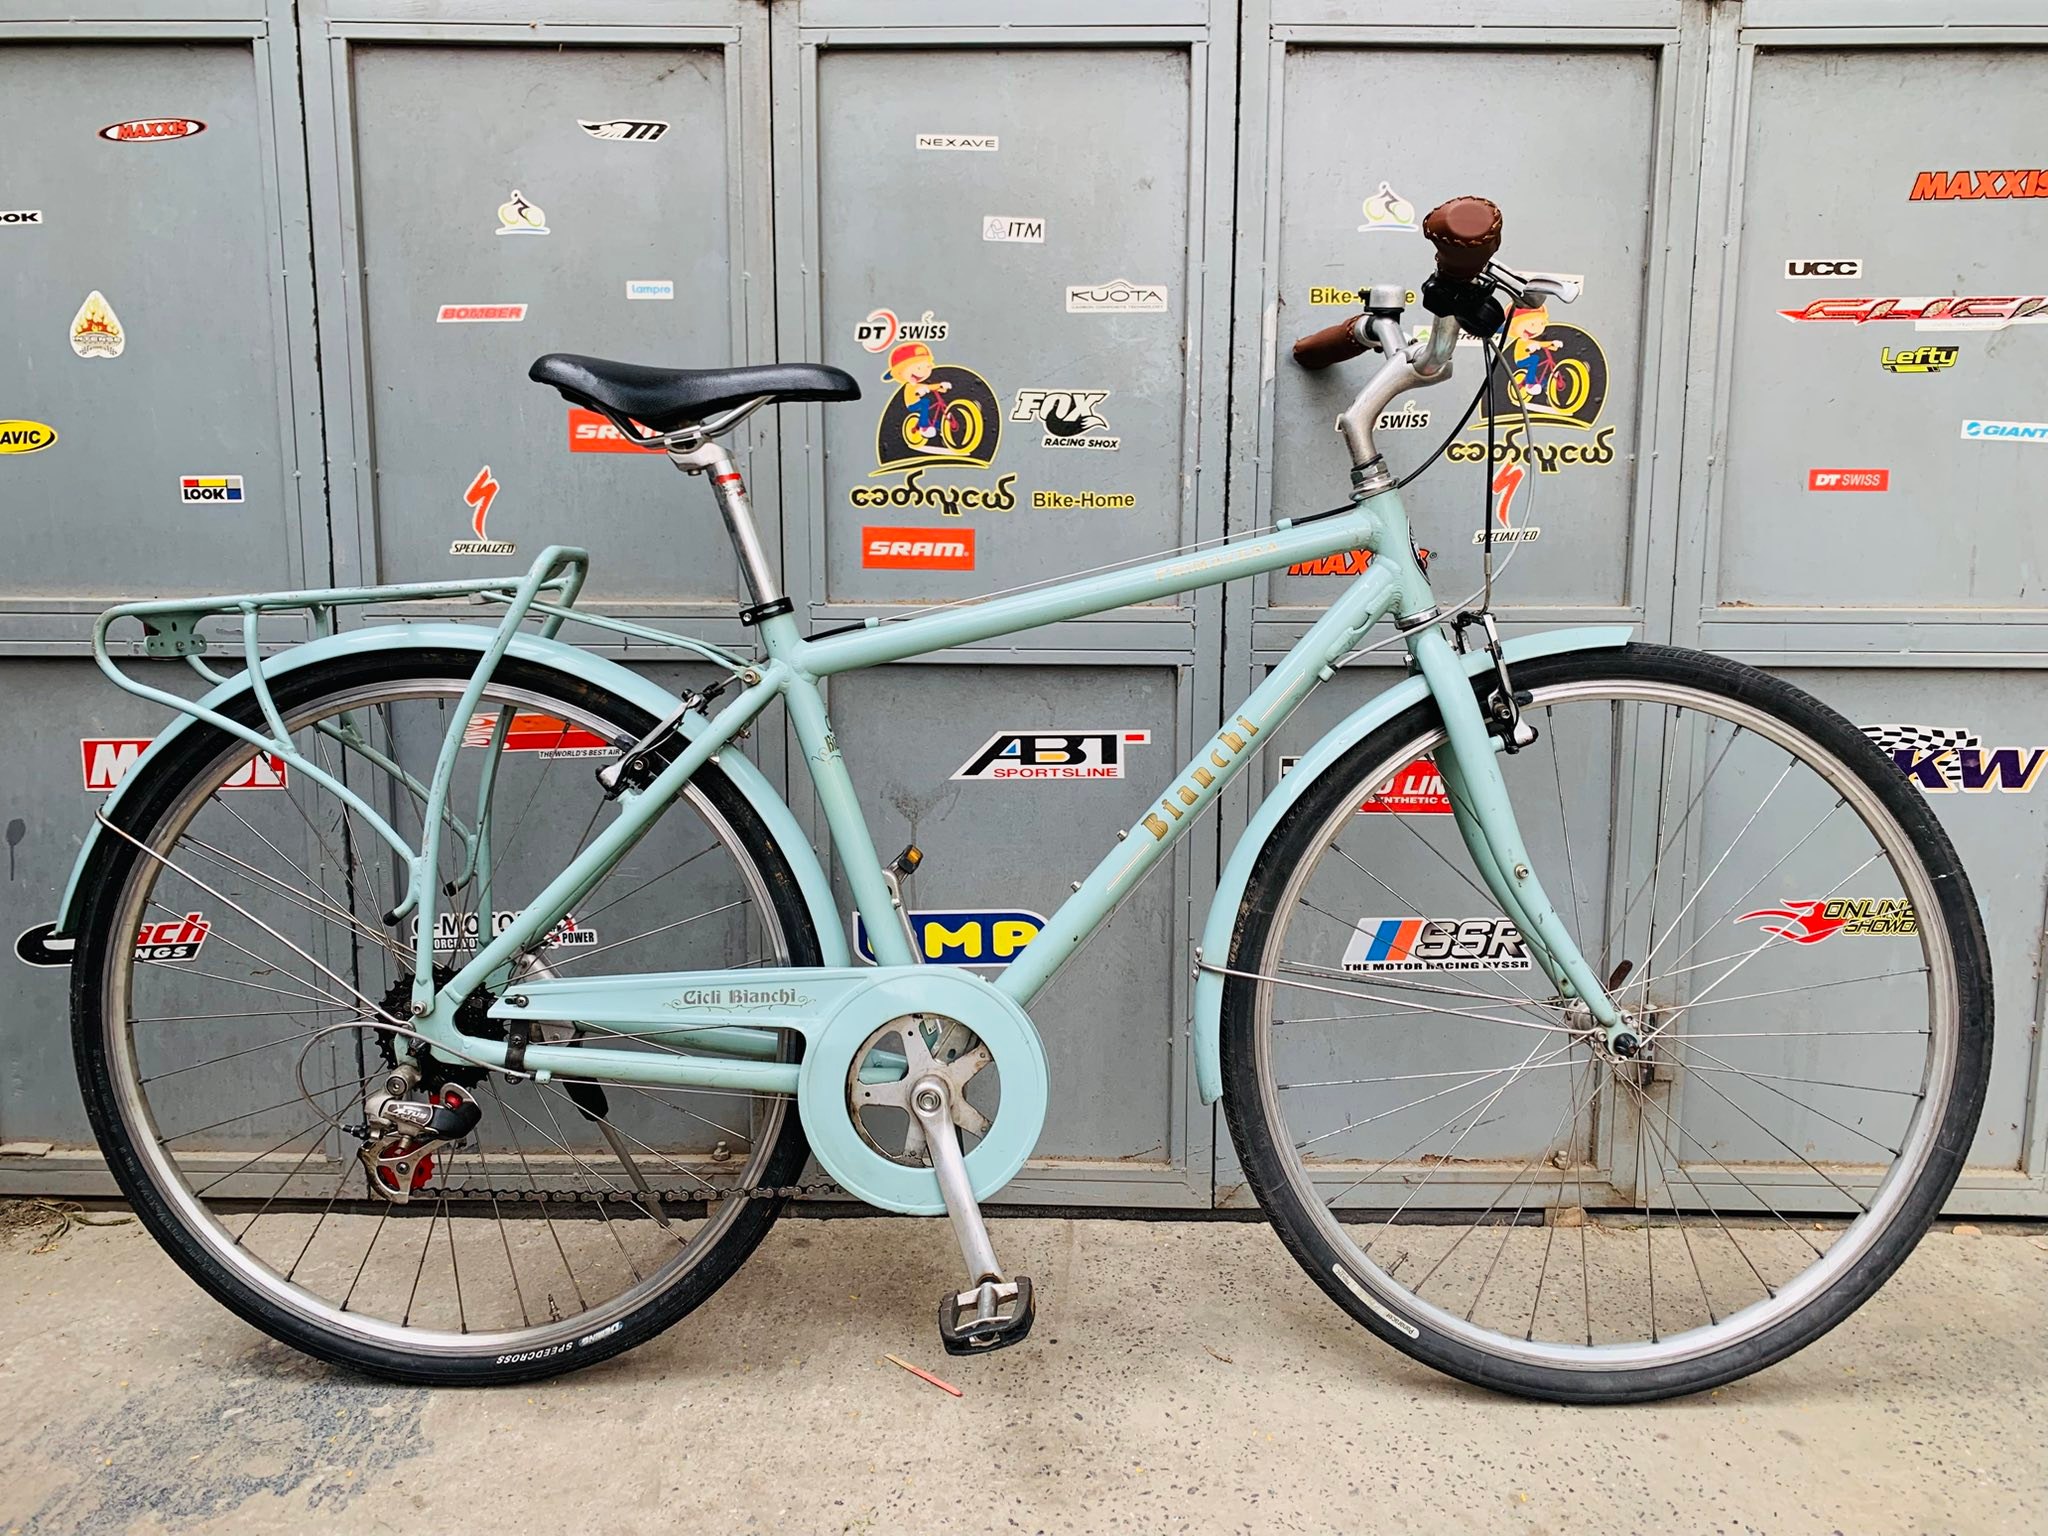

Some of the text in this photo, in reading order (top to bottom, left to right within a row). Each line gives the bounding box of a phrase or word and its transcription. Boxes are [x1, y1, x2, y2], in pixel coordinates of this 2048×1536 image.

[118, 121, 188, 140] MAXXIS
[919, 137, 996, 148] NEXAVE
[0, 213, 39, 223] OK
[1007, 221, 1042, 239] ITM
[1788, 261, 1858, 276] UCC
[1071, 290, 1163, 303] KUOTA
[1310, 288, 1416, 304] Bike-e
[441, 307, 523, 319] BOMBER
[857, 325, 947, 340] DT SWISS
[1882, 347, 1960, 368] Lefty
[1011, 391, 1108, 422] FOX
[1379, 413, 1429, 429] SWISS
[0, 430, 41, 444] AVIC
[1983, 425, 2048, 439] GIANT
[1044, 438, 1119, 448] RACING SHOX
[1815, 473, 1881, 486] DT SWISS
[184, 488, 226, 500] LOOK
[1033, 492, 1136, 508] Bike-Home
[1477, 530, 1539, 543] SECIALIED
[453, 543, 515, 554] SPECIALIZED
[868, 541, 965, 557] SRAM
[961, 734, 1118, 776] ABT
[993, 767, 1118, 778] SPORTSLINE
[1141, 714, 1260, 842] Bianchi
[1402, 775, 1446, 795] LIN
[562, 931, 595, 944] POWER
[1414, 920, 1528, 960] SSR
[1344, 963, 1371, 972] THE
[1372, 962, 1423, 971] MOTOR
[728, 988, 796, 1006] Bianchi
[496, 1341, 574, 1365] SPEEDCROSS
